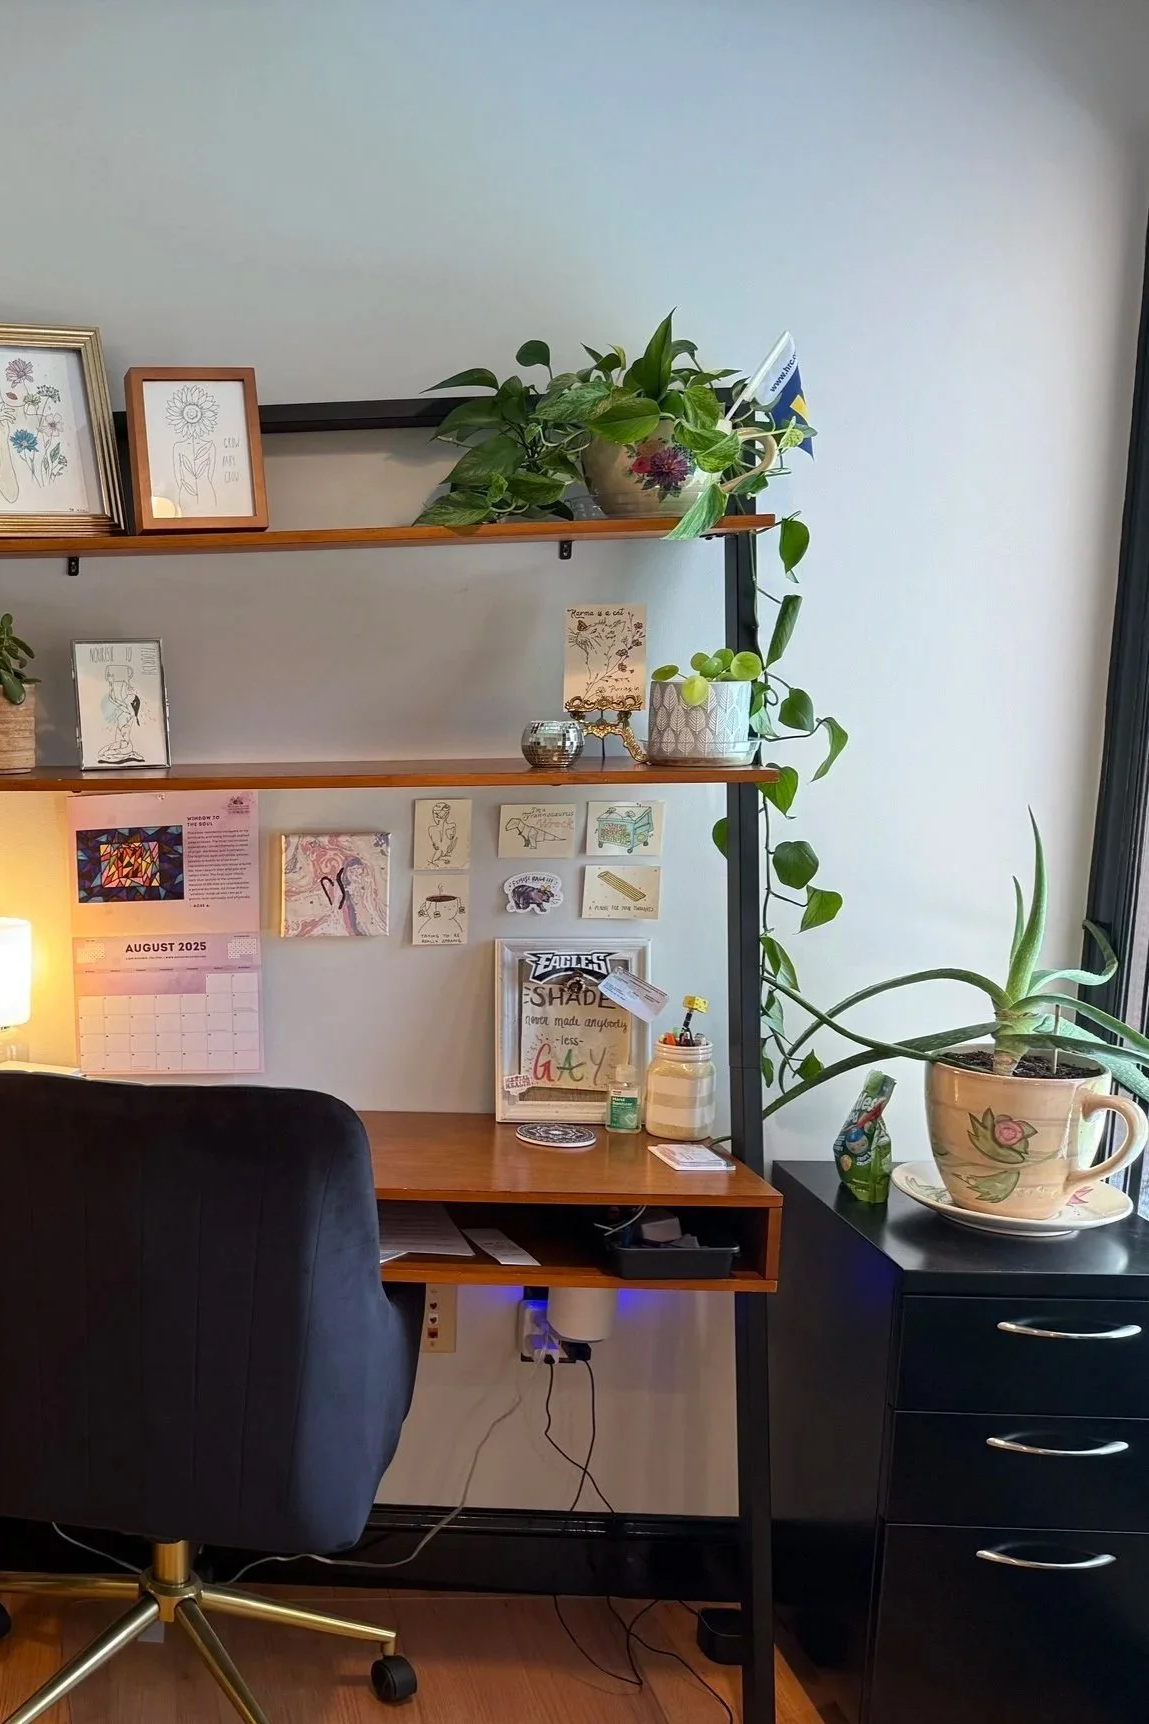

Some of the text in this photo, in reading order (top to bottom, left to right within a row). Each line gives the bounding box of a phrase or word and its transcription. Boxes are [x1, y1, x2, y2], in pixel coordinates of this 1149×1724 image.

[125, 941, 207, 953] AUGUST 2025
[533, 953, 609, 977] EAGLES
[530, 986, 616, 1009] SHADE
[554, 1015, 580, 1028] made
[584, 1017, 628, 1033] anybody
[533, 1043, 608, 1086] GAY
